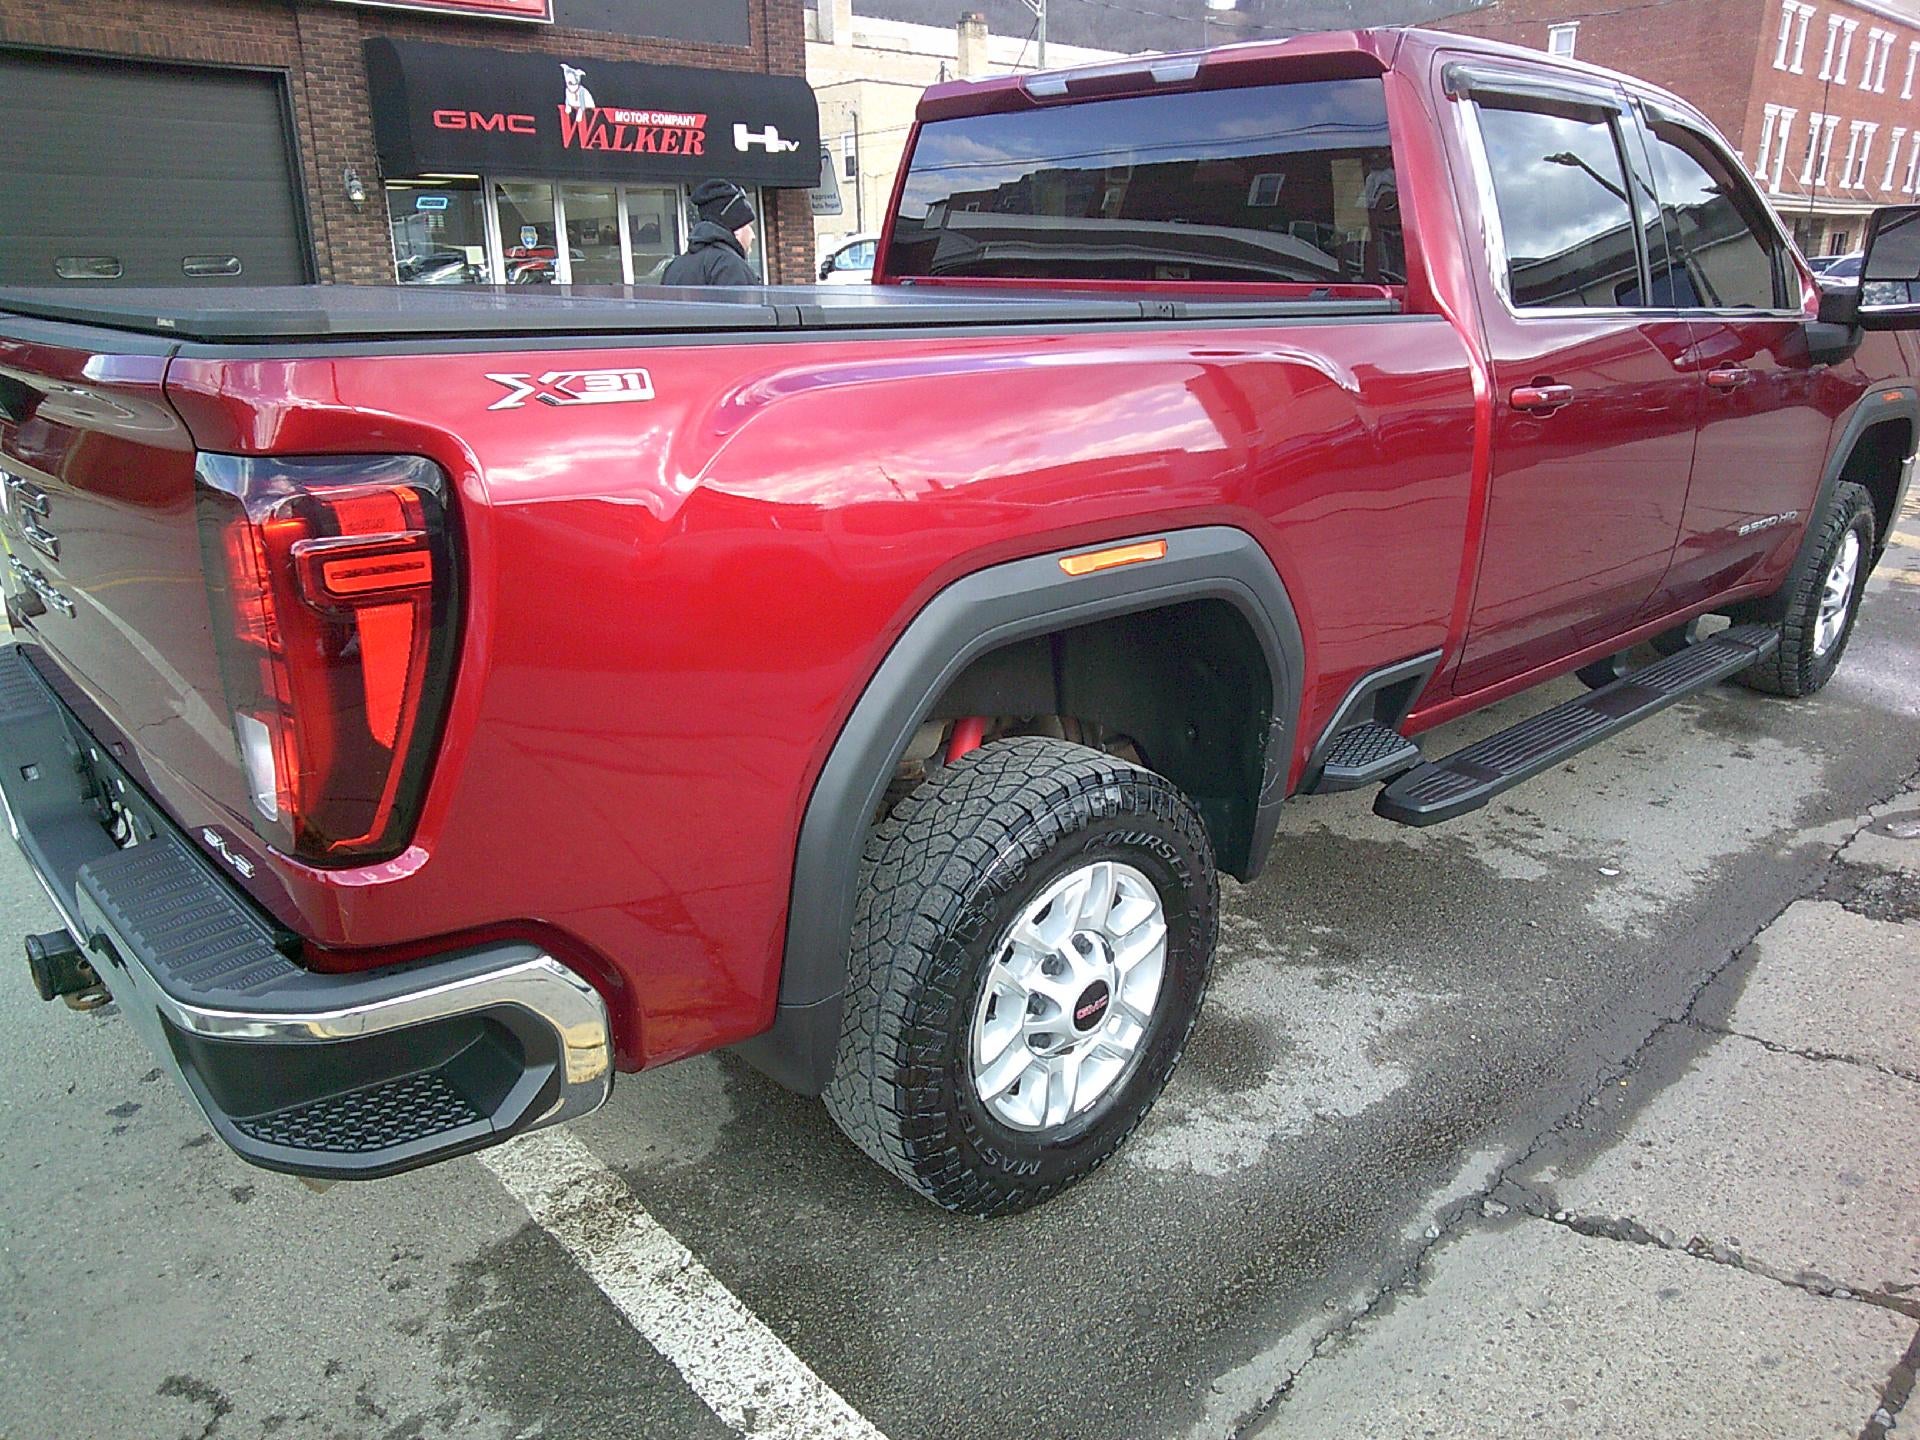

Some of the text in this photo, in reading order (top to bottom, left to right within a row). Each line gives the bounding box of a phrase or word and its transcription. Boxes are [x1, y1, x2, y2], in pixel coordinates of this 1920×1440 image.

[433, 110, 536, 134] GMC
[557, 104, 706, 156] WALKER
[614, 110, 697, 127] MOTOR COMPANY
